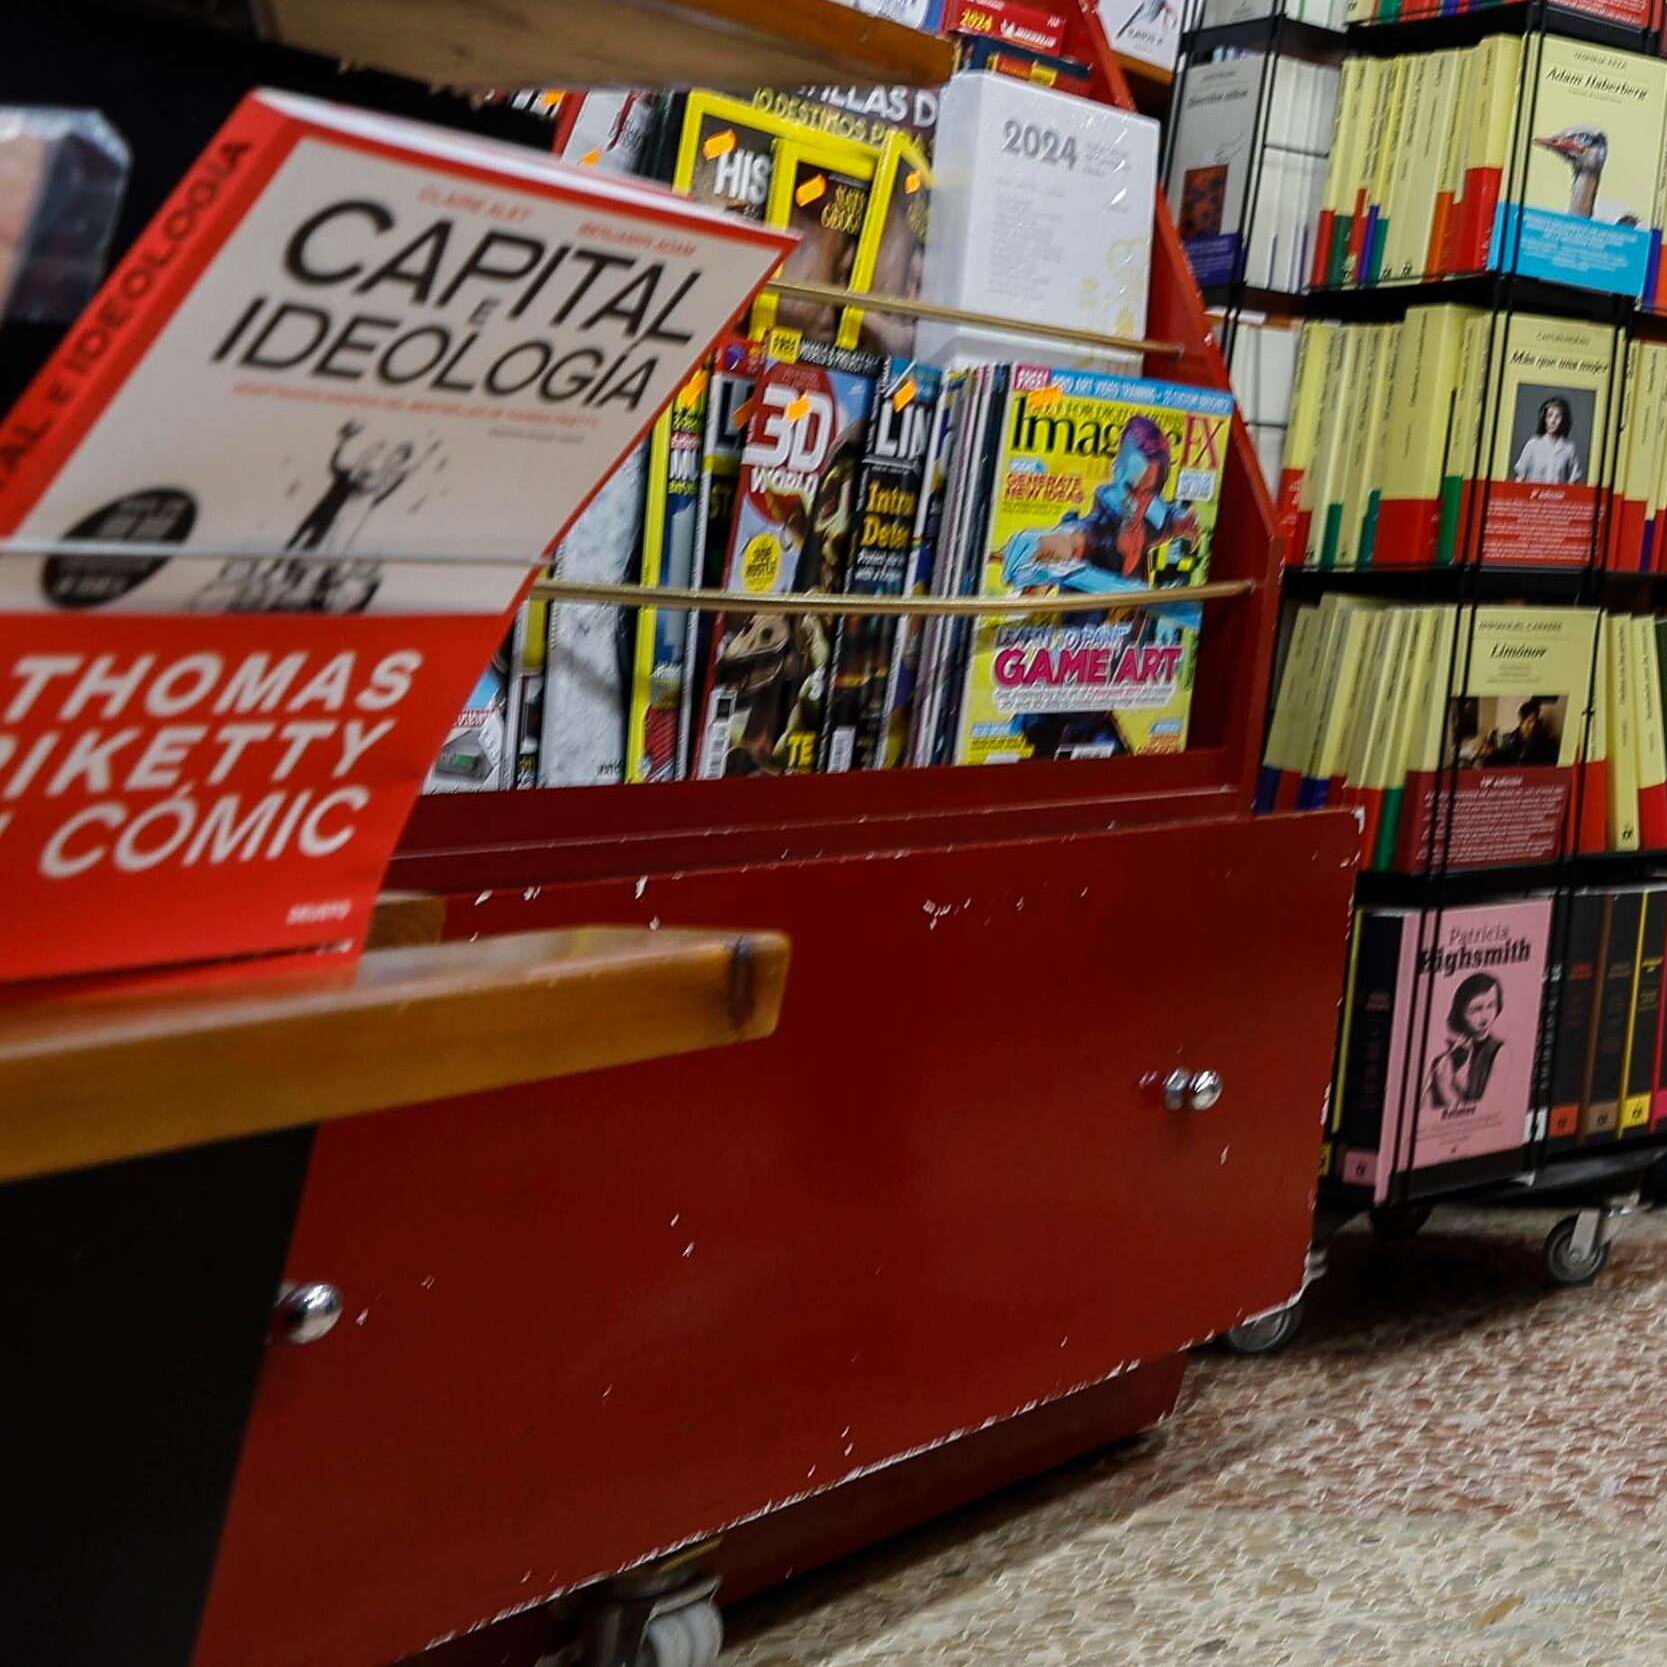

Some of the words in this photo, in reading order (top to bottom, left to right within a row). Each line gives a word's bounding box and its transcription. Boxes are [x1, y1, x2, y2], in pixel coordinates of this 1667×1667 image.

[959, 8, 996, 34] 2024
[1545, 66, 1583, 88] Adam
[1585, 72, 1649, 101] Haberberg
[1001, 119, 1079, 171] 2024
[283, 197, 704, 346] CAPITAL
[466, 297, 502, 328] E
[208, 294, 661, 414] IDEOLOGÍA
[742, 383, 835, 475] 3D
[750, 464, 820, 500] WORLD
[1004, 486, 1044, 504] NEW
[1045, 488, 1086, 506] IDEAS
[1005, 471, 1083, 492] GENERATE
[994, 646, 1111, 689] GAME
[1112, 646, 1184, 684] ART
[1488, 642, 1548, 662] Limónov
[3, 647, 426, 727] THOMAS
[38, 781, 372, 882] CÓMIC
[1448, 924, 1510, 945] Patricia
[1418, 939, 1532, 976] Highsmith
